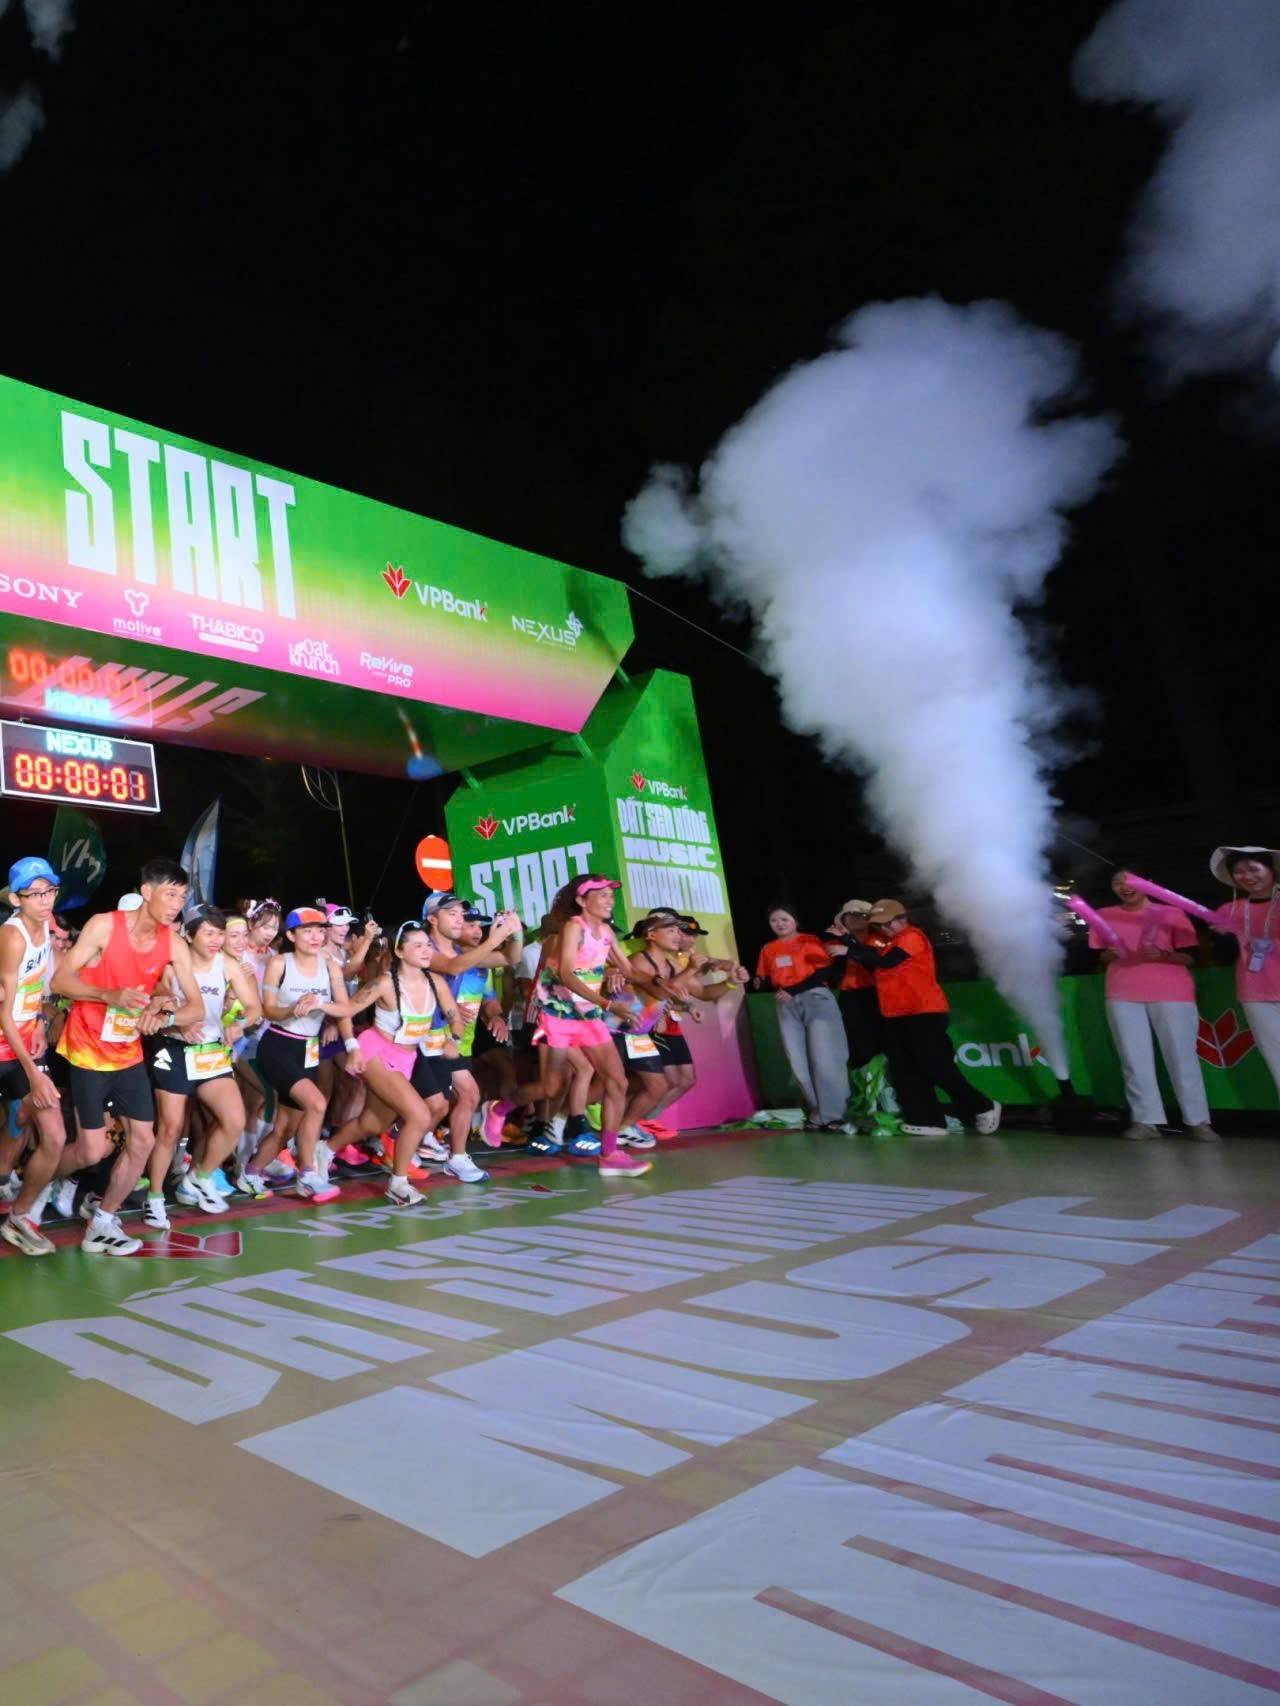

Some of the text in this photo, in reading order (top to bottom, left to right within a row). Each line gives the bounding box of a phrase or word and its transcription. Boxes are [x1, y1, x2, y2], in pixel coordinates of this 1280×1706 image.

[60, 410, 296, 620] START
[414, 581, 488, 623] VPBank
[113, 617, 162, 638] motive
[189, 613, 265, 645] THABICO
[511, 615, 577, 647] NEXUS
[387, 674, 413, 688] PRO
[45, 730, 113, 760] NEXUS
[14, 752, 147, 802] 00:00:01
[646, 779, 687, 800] VPBank
[502, 803, 576, 836] VPBank
[622, 836, 718, 869] MUSIC
[626, 861, 726, 915] MARATHON
[954, 1033, 1050, 1068] ank
[318, 1225, 777, 1317] SEN
[237, 1196, 1242, 1559] MUSIC
